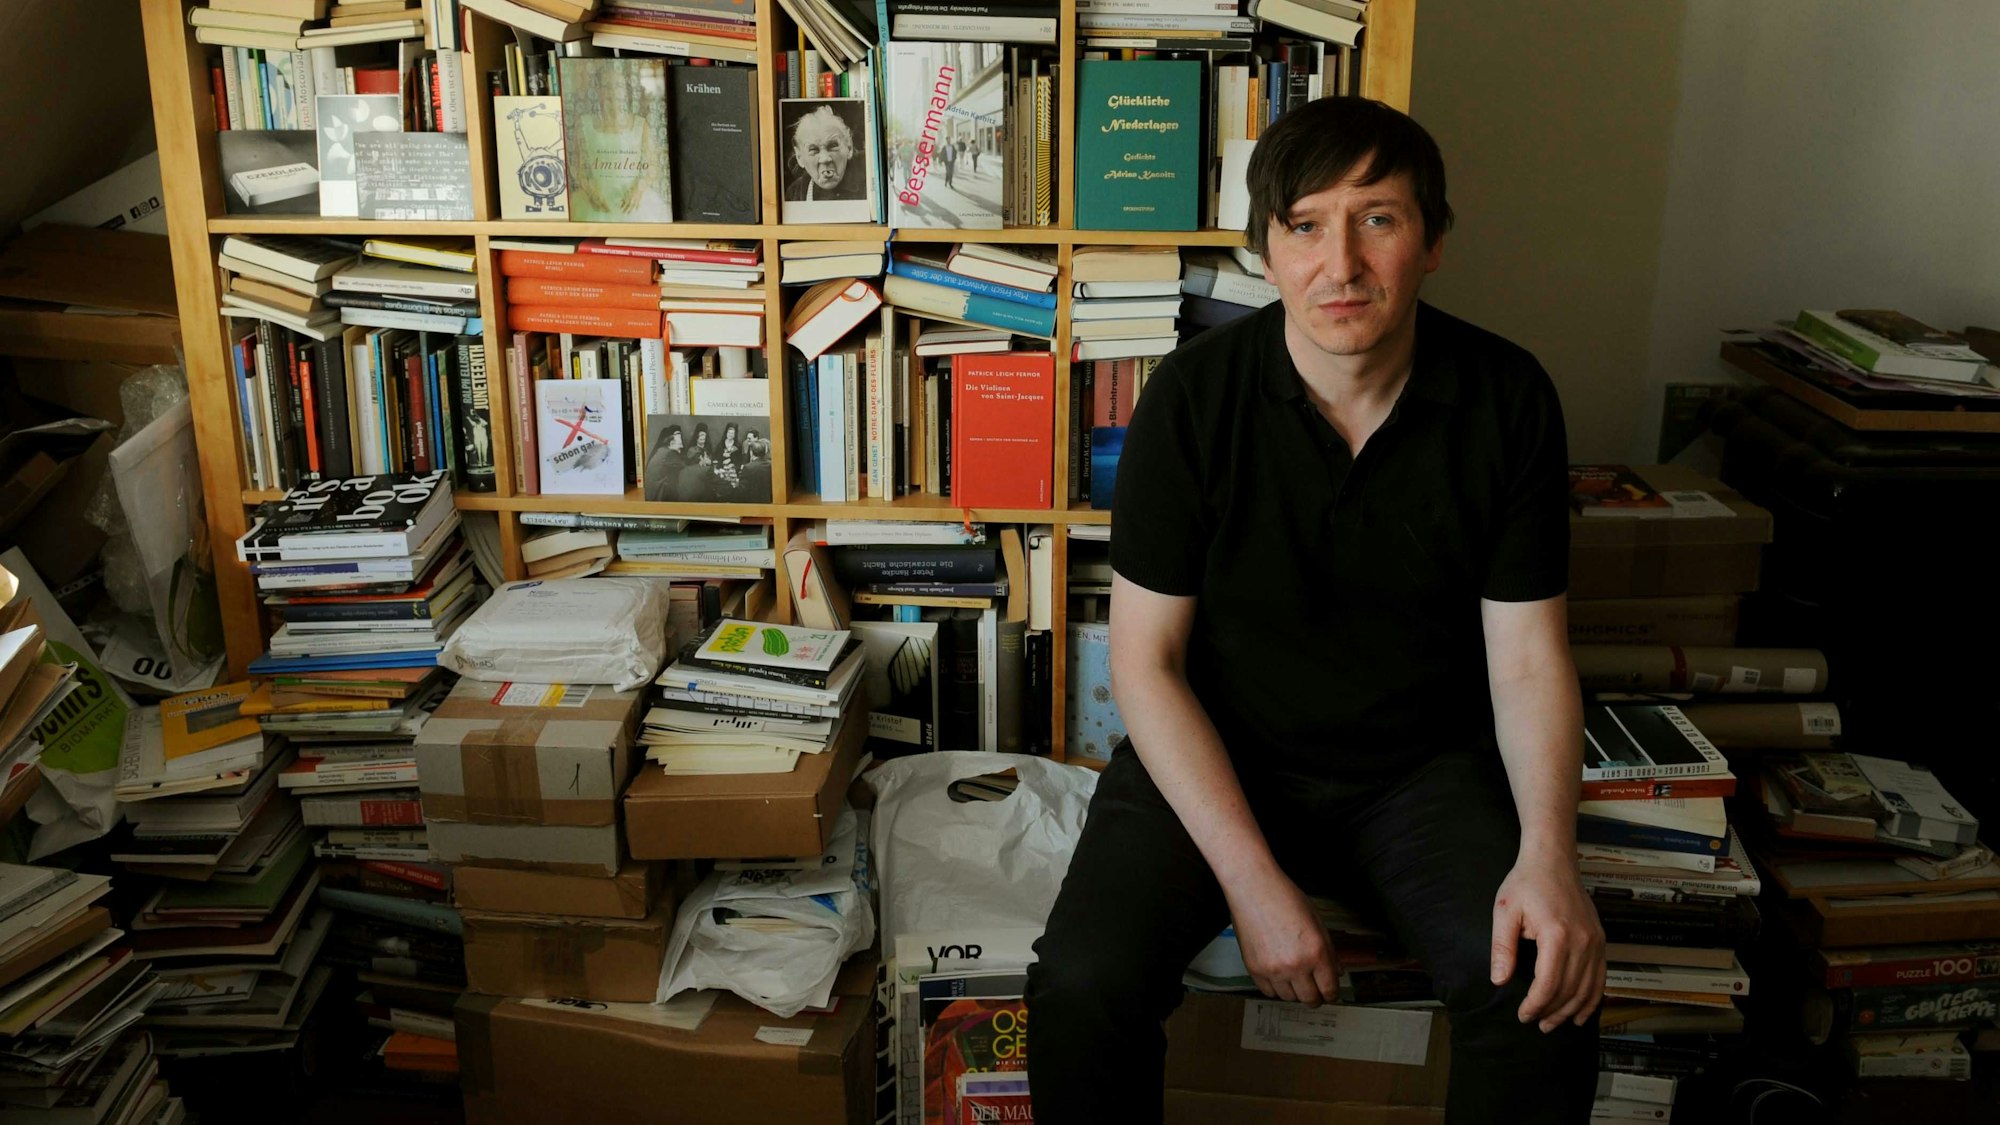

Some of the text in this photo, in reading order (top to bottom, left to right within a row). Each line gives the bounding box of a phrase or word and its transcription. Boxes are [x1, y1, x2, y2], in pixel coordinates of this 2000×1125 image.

[295, 55, 307, 104] Moscoviad
[686, 83, 721, 95] Krähen
[1107, 95, 1170, 108] Glückliche
[946, 105, 970, 117] Adrian
[1101, 119, 1179, 134] Niederlagen
[899, 65, 956, 207] Bessermann
[593, 157, 649, 170] Amuleto
[1123, 153, 1156, 162] Gedichte
[1104, 170, 1176, 180] Adrian Kasnitz
[911, 269, 1029, 301] Max Frisch Antwort aus der Stille
[443, 307, 465, 316] Carlos
[458, 344, 473, 403] RALPH ELLISON
[469, 344, 489, 410] JUNETEENTH
[996, 393, 1044, 401] Saint-Jacques
[1109, 361, 1118, 420] Blechtromm
[650, 387, 659, 414] Bouvard
[415, 421, 423, 438] Durych
[553, 440, 596, 464] schon gar
[863, 561, 886, 569] Nacht
[888, 561, 937, 569] morawische
[882, 569, 909, 577] Handke
[748, 667, 767, 676] Espedal
[768, 670, 786, 679] Thomas
[60, 700, 119, 754] BIOMARKT
[877, 715, 903, 726] Kristof
[1682, 728, 1698, 737] DE
[1694, 741, 1720, 761] CABO
[1601, 770, 1621, 778] GATA
[1636, 768, 1656, 776] CABO
[1664, 767, 1683, 775] RUGE
[1687, 765, 1710, 774] EUGEN
[1615, 874, 1663, 885] Verschwinden
[1682, 881, 1715, 890] Edschmid
[1716, 884, 1738, 892] Ulrike
[927, 944, 982, 959] VOR
[1896, 958, 1972, 979] PUZZLE 100
[1905, 988, 1979, 1020] GEISTER
[1935, 1001, 1996, 1023] TREPPE
[992, 1009, 1028, 1034] OS
[993, 1035, 1027, 1059] GE
[971, 1106, 1033, 1121] DER MAU
